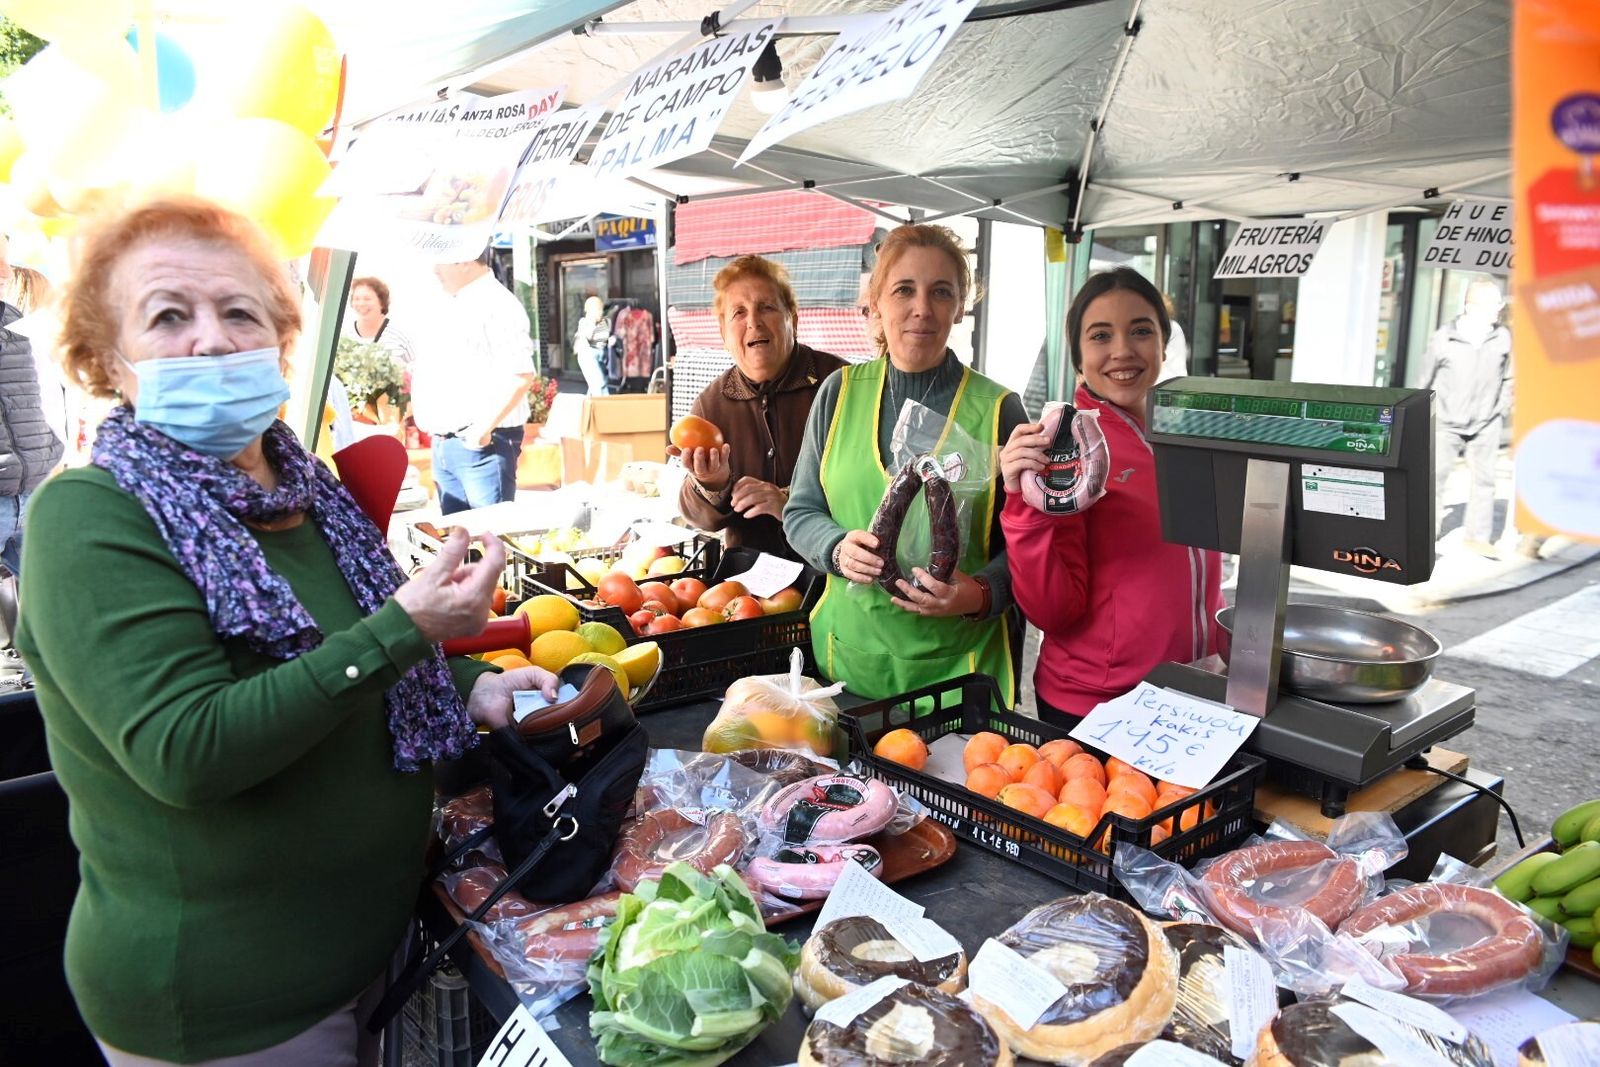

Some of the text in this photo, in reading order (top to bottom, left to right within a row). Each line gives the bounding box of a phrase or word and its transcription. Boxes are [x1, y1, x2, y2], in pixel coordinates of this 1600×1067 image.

[626, 23, 775, 101] NARANJAS
[460, 91, 559, 122] ANTA ROSA DAY
[604, 66, 747, 140] DE CAMPO
[1233, 219, 1325, 248] FRUTERÍA
[1435, 225, 1516, 244] DE HINO
[1216, 252, 1314, 276] MILAGROS
[1425, 246, 1461, 264] DEL
[1346, 440, 1377, 450] DINA
[1332, 549, 1402, 572] DINA
